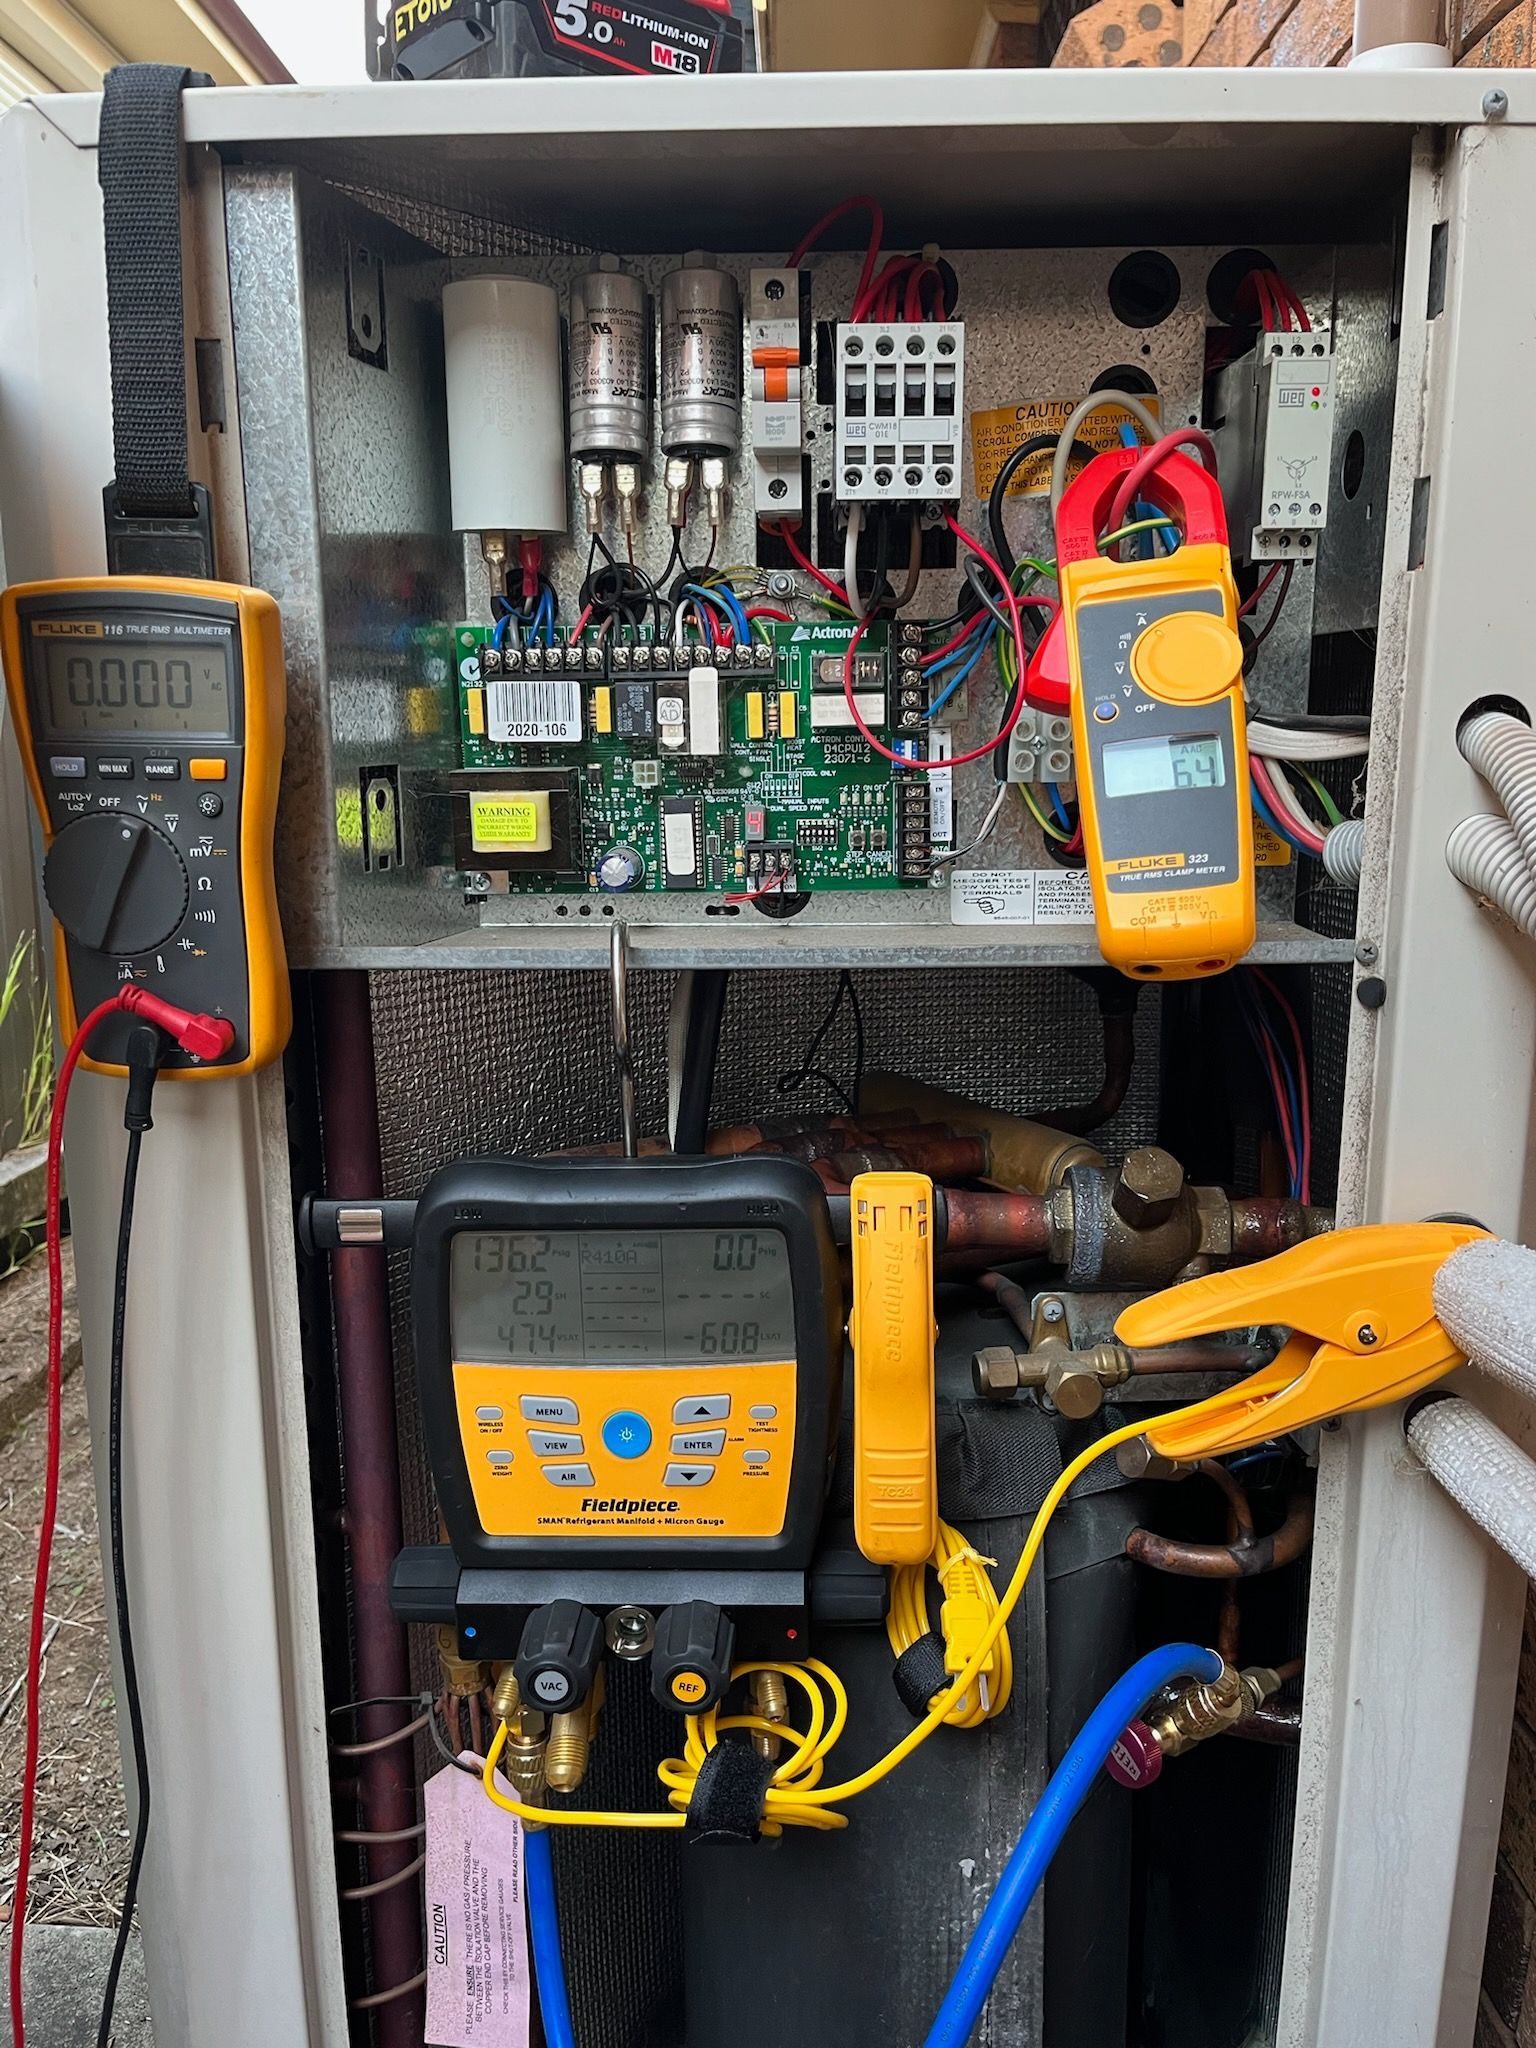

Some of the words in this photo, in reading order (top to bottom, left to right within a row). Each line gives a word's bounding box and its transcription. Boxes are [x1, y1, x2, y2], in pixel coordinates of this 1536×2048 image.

[613, 37, 626, 47] Ah
[653, 44, 697, 72] M18
[976, 426, 992, 437] AIR
[995, 418, 1061, 435] CONDITIONER
[1110, 414, 1136, 425] WITH
[976, 437, 1013, 449] SCROLL
[1080, 426, 1098, 436] AND
[1094, 438, 1115, 448] NOT
[978, 461, 991, 472] OR
[1010, 480, 1028, 490] THIS
[38, 624, 97, 635] FLUKE
[104, 624, 124, 636] 116
[126, 625, 149, 635] TRUE
[150, 626, 171, 635] RMS
[174, 626, 232, 636] MULTIMETER
[67, 657, 193, 709] 0.000
[203, 669, 211, 680] V
[211, 682, 223, 692] AC
[1095, 694, 1116, 702] HOLD
[1135, 703, 1156, 714] OFF
[508, 723, 567, 737] 2020-106
[824, 754, 871, 764] 23071-6
[54, 763, 78, 772] HOLD
[98, 764, 113, 774] MIN
[112, 764, 129, 774] MAX
[145, 765, 174, 775] RANGE
[874, 784, 887, 792] OFF
[58, 792, 92, 802] AUTO-V
[98, 797, 121, 807] OFF
[150, 794, 163, 802] Hz
[68, 802, 85, 812] LoZ
[138, 802, 148, 813] V
[478, 808, 530, 816] WARNING
[1256, 832, 1272, 841] THE
[190, 846, 213, 858] mV
[1118, 856, 1177, 871] FLUKE
[1188, 854, 1209, 864] 323
[1120, 872, 1142, 882] TRUE
[1144, 871, 1163, 880] RMS
[1164, 867, 1194, 878] CLAMP
[1196, 866, 1226, 874] METER
[1130, 916, 1157, 926] COM
[454, 1208, 483, 1220] LOW
[747, 1204, 780, 1216] HIGH
[474, 1236, 551, 1273] 136.2
[581, 1250, 637, 1265] R410A
[713, 1234, 758, 1271] 0.0
[513, 1280, 553, 1316] 2.9
[882, 1241, 904, 1362] Fieldpiece
[498, 1323, 556, 1355] 47.4
[536, 1408, 563, 1416] MENU
[544, 1442, 568, 1450] VIEW
[561, 1473, 577, 1481] AIR
[878, 1484, 913, 1499] TC24
[581, 1498, 679, 1515] Fieldpiece
[566, 1517, 615, 1526] Refrigerant
[617, 1517, 655, 1525] Manifold
[664, 1517, 695, 1525] Micron
[698, 1518, 725, 1526] Gauge
[540, 1680, 563, 1692] VAC
[678, 1681, 700, 1694] REF
[472, 1858, 480, 1875] THE
[480, 1867, 489, 1912] REMOVING
[463, 1892, 471, 1910] GAS
[464, 1911, 472, 1922] NO
[472, 1897, 480, 1921] VALVE
[433, 1904, 445, 1965] CAUTION
[465, 1923, 473, 1931] IS
[482, 1914, 491, 1943] BEFORE
[465, 1933, 474, 1959] THERE
[474, 1923, 482, 1963] ISOLATION
[500, 1930, 508, 1969] CONNECTING
[484, 1963, 492, 1979] END
[466, 1964, 474, 1996] ENSURE
[476, 1982, 484, 2022] BETWEEN
[484, 1980, 493, 2015] COPPER
[465, 2001, 474, 2035] PLEASE
